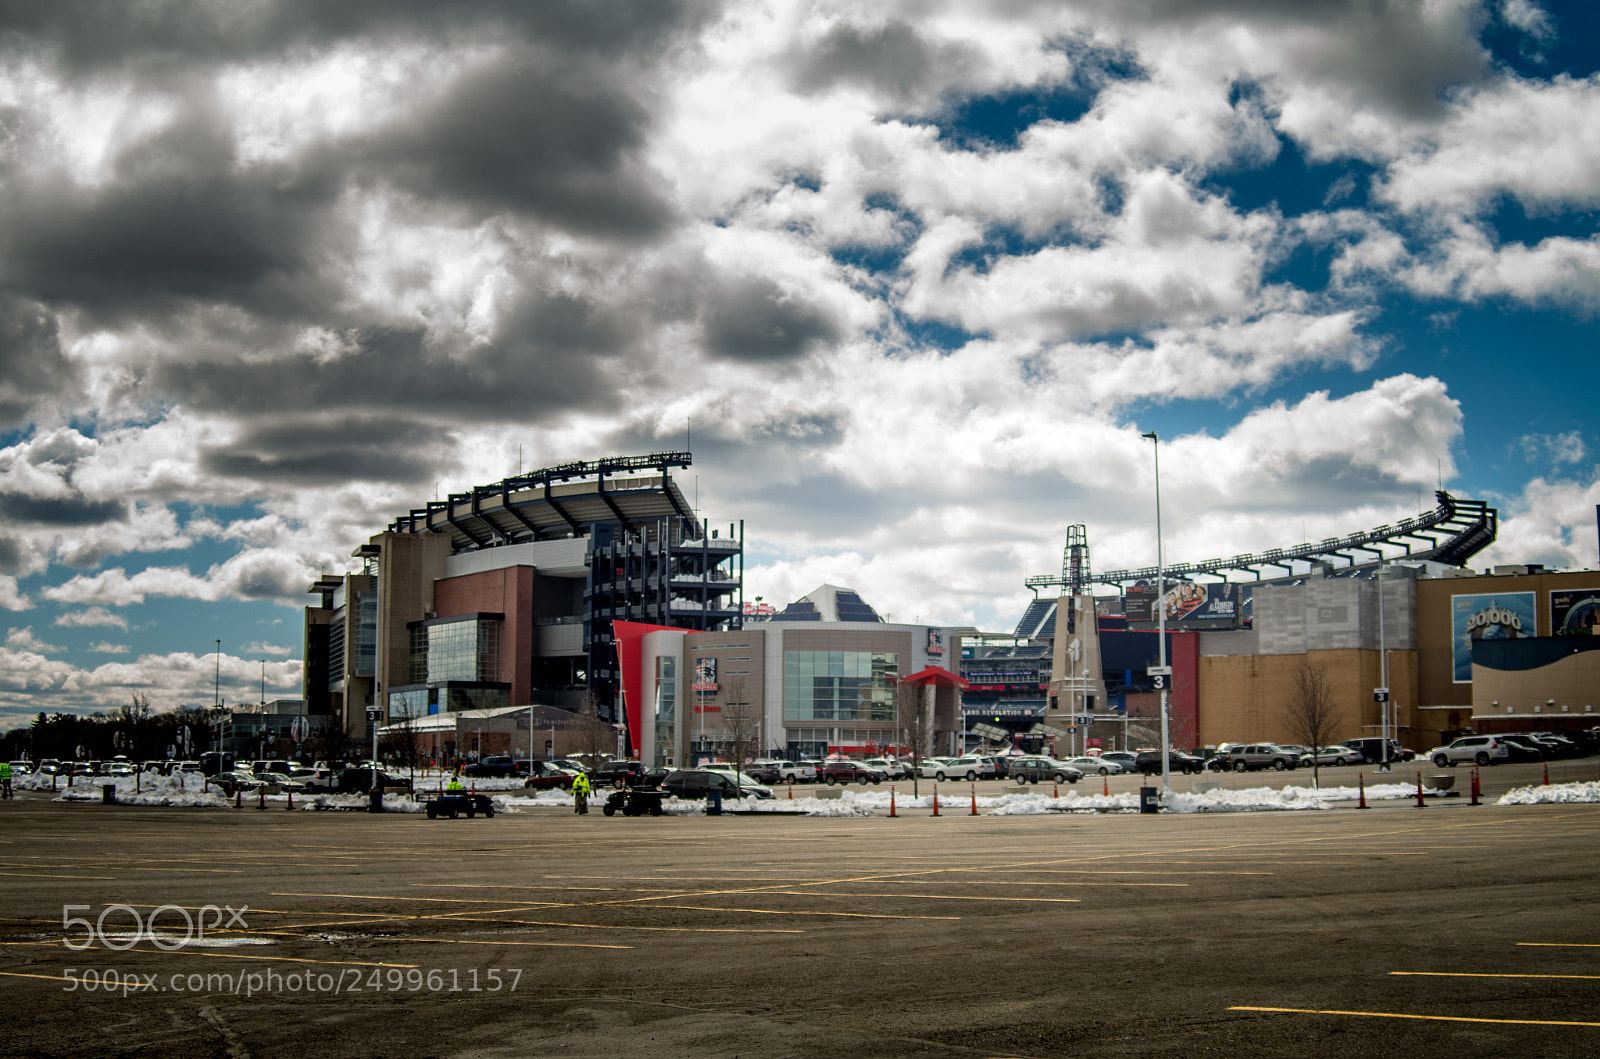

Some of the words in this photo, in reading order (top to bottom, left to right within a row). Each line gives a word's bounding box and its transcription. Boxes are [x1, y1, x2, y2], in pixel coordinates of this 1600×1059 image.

[1467, 611, 1522, 631] 20,000
[1154, 676, 1164, 689] 3
[369, 711, 375, 720] 3
